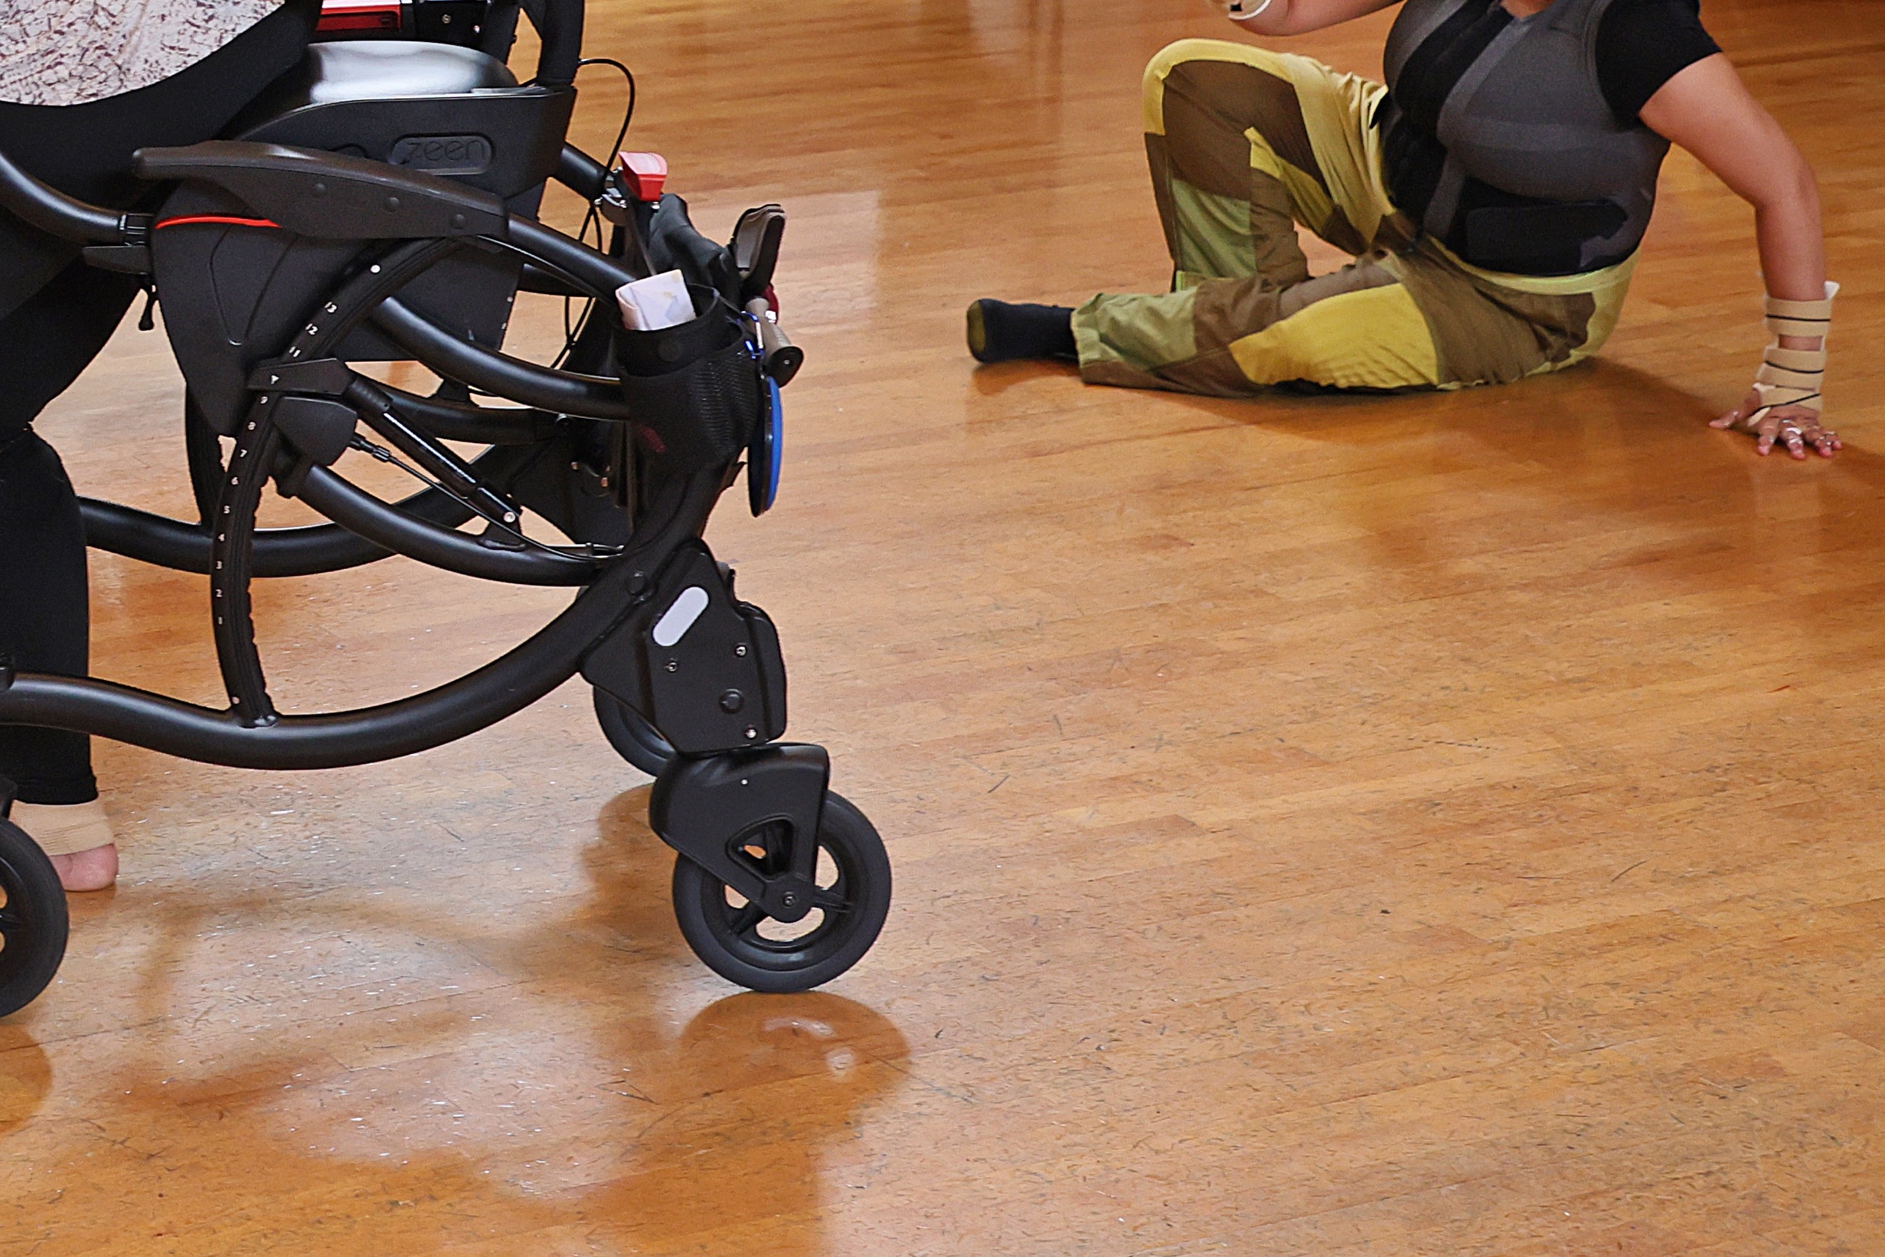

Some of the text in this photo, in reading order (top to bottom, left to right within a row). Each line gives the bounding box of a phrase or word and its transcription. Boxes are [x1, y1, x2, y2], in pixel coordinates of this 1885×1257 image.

[406, 139, 487, 163] zeen
[324, 301, 338, 314] 13
[305, 323, 319, 336] 12
[288, 345, 301, 358] 11
[239, 449, 248, 458] 7
[230, 476, 240, 486] 6
[223, 505, 231, 514] 5
[217, 533, 226, 542] 4
[215, 560, 223, 570] 3
[215, 588, 223, 598] 2
